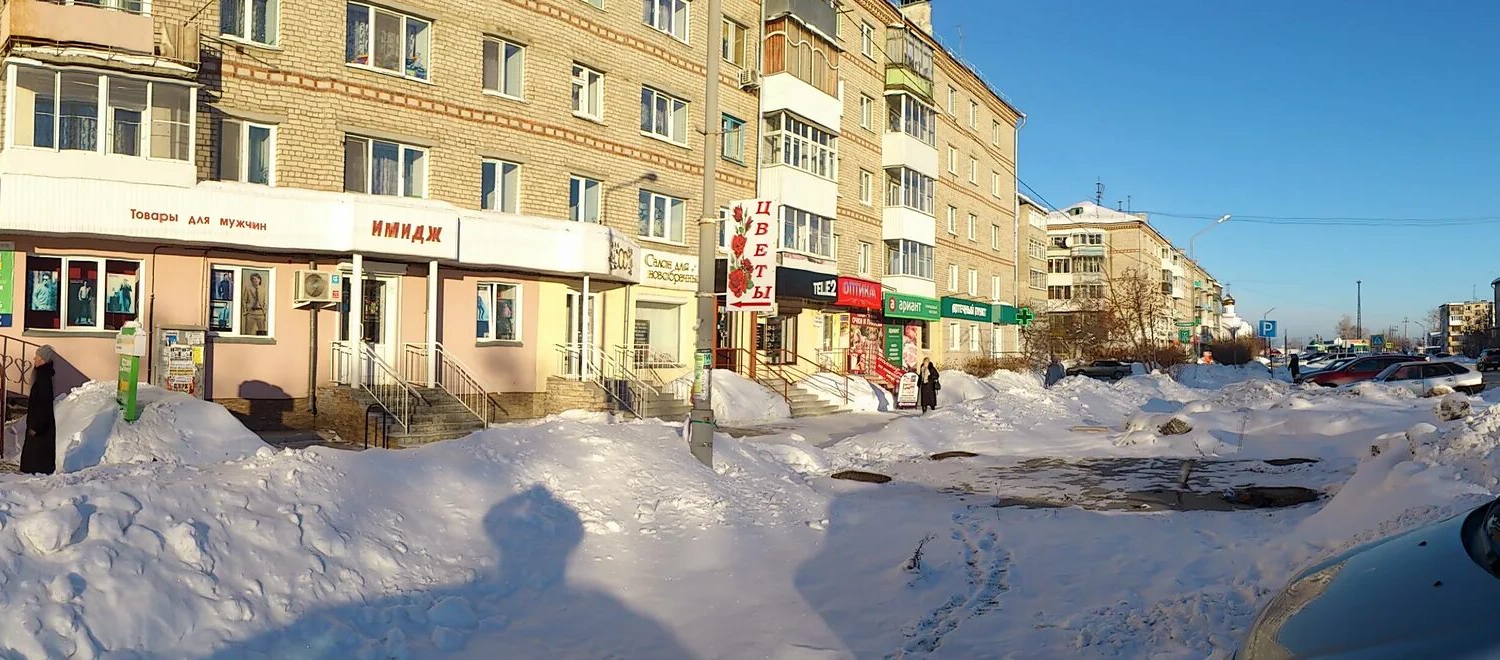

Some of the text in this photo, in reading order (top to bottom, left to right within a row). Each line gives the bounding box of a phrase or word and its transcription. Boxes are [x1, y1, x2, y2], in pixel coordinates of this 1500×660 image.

[130, 208, 267, 231] Товары для мужчин
[371, 220, 443, 244] ИМИДЖ
[751, 200, 772, 299] ЦВЕТЫ
[644, 253, 690, 272] Салон для
[813, 279, 837, 297] TELE2
[843, 282, 877, 299] ОПТИКА
[898, 300, 922, 313] ариант
